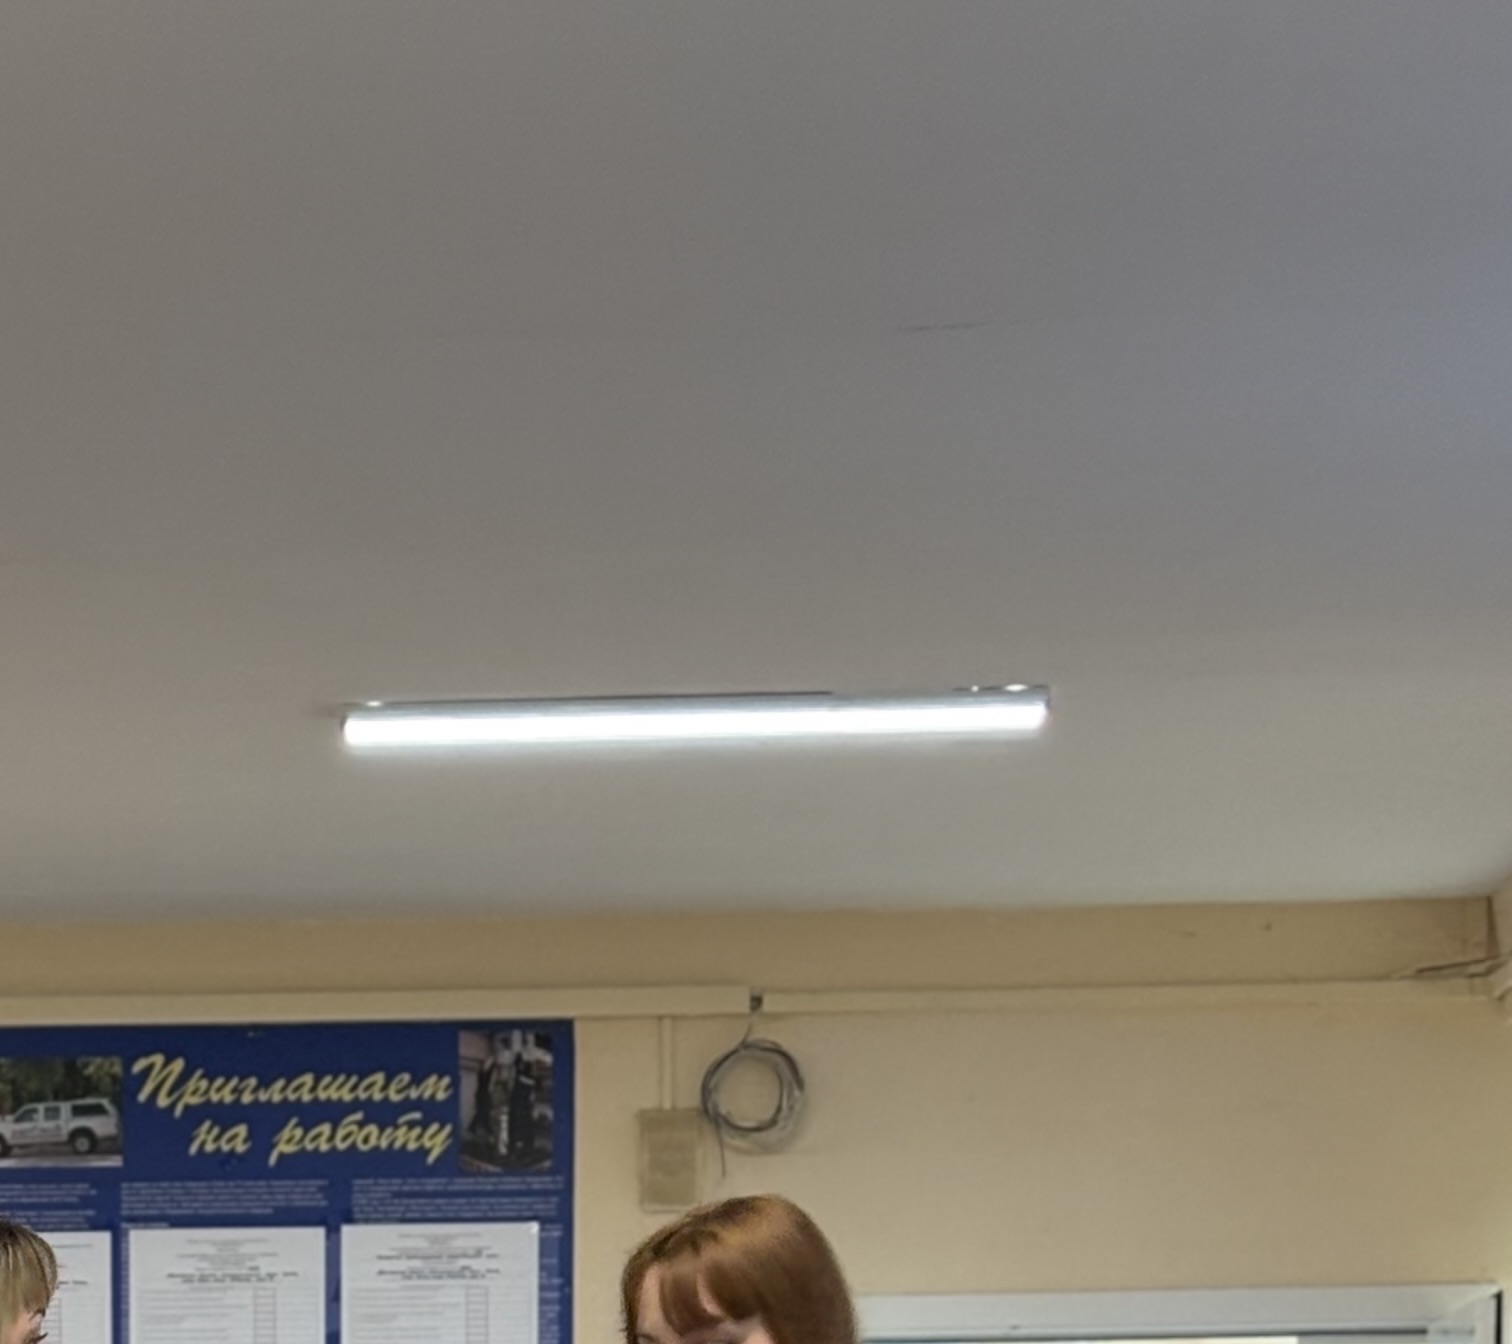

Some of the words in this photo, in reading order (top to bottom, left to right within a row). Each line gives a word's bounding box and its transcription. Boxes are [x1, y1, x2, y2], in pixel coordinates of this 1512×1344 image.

[131, 1053, 453, 1119] Приглашаем
[189, 1119, 252, 1156] на
[268, 1110, 453, 1168] работу
